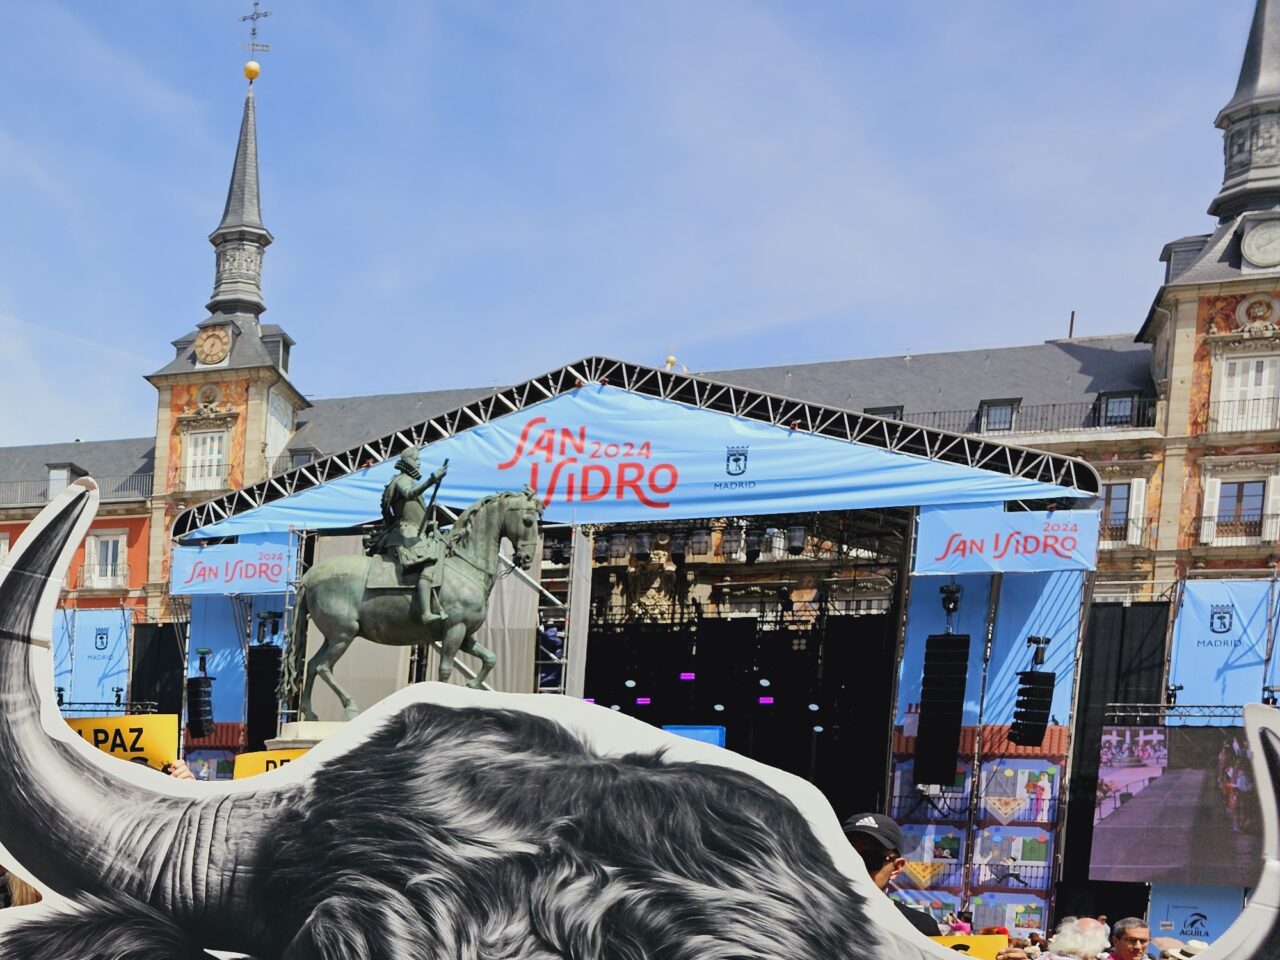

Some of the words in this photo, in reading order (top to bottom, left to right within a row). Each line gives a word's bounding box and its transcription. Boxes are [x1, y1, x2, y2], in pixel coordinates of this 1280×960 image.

[498, 417, 587, 470] SAN
[589, 441, 652, 461] 2024
[530, 458, 679, 509] ISIDRO
[714, 481, 756, 490] MADRID
[1042, 522, 1078, 532] 2024
[935, 533, 984, 561] SAN
[993, 531, 1078, 559] ISIDRO
[184, 560, 219, 584] SAN
[224, 560, 282, 583] ISIDRO
[1196, 640, 1242, 648] MADRID
[93, 728, 145, 753] PAZ
